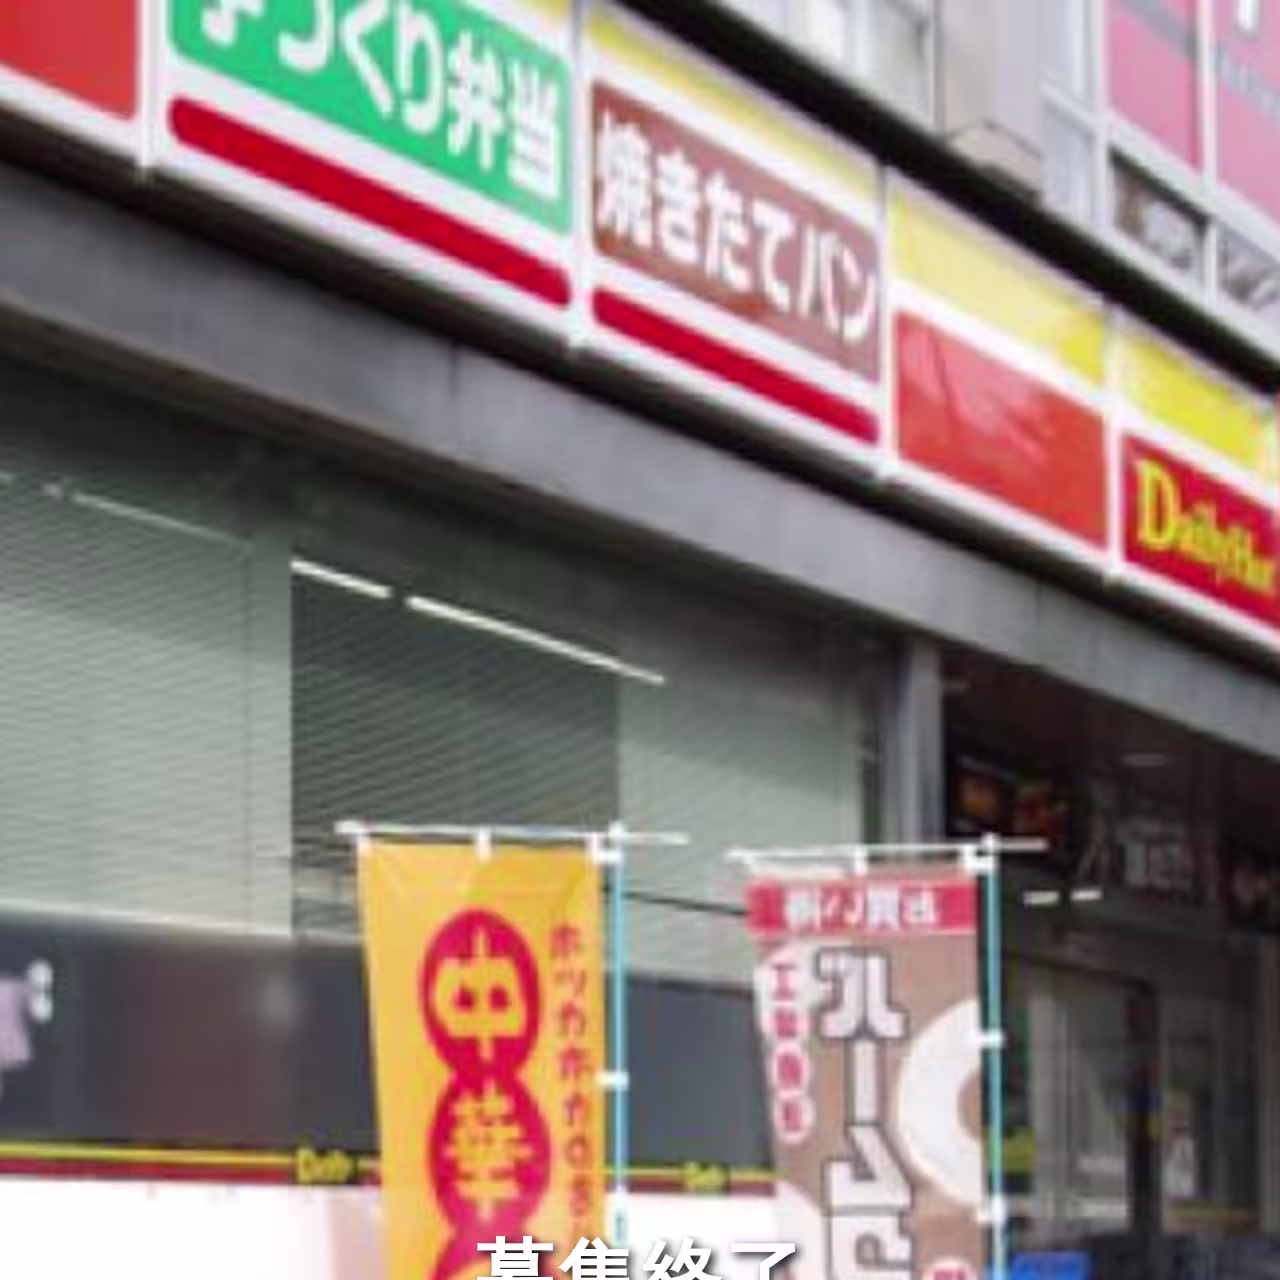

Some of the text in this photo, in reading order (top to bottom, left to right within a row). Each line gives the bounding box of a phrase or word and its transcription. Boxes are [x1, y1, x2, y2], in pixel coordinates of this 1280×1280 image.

[595, 108, 877, 346] 焼きたてパン
